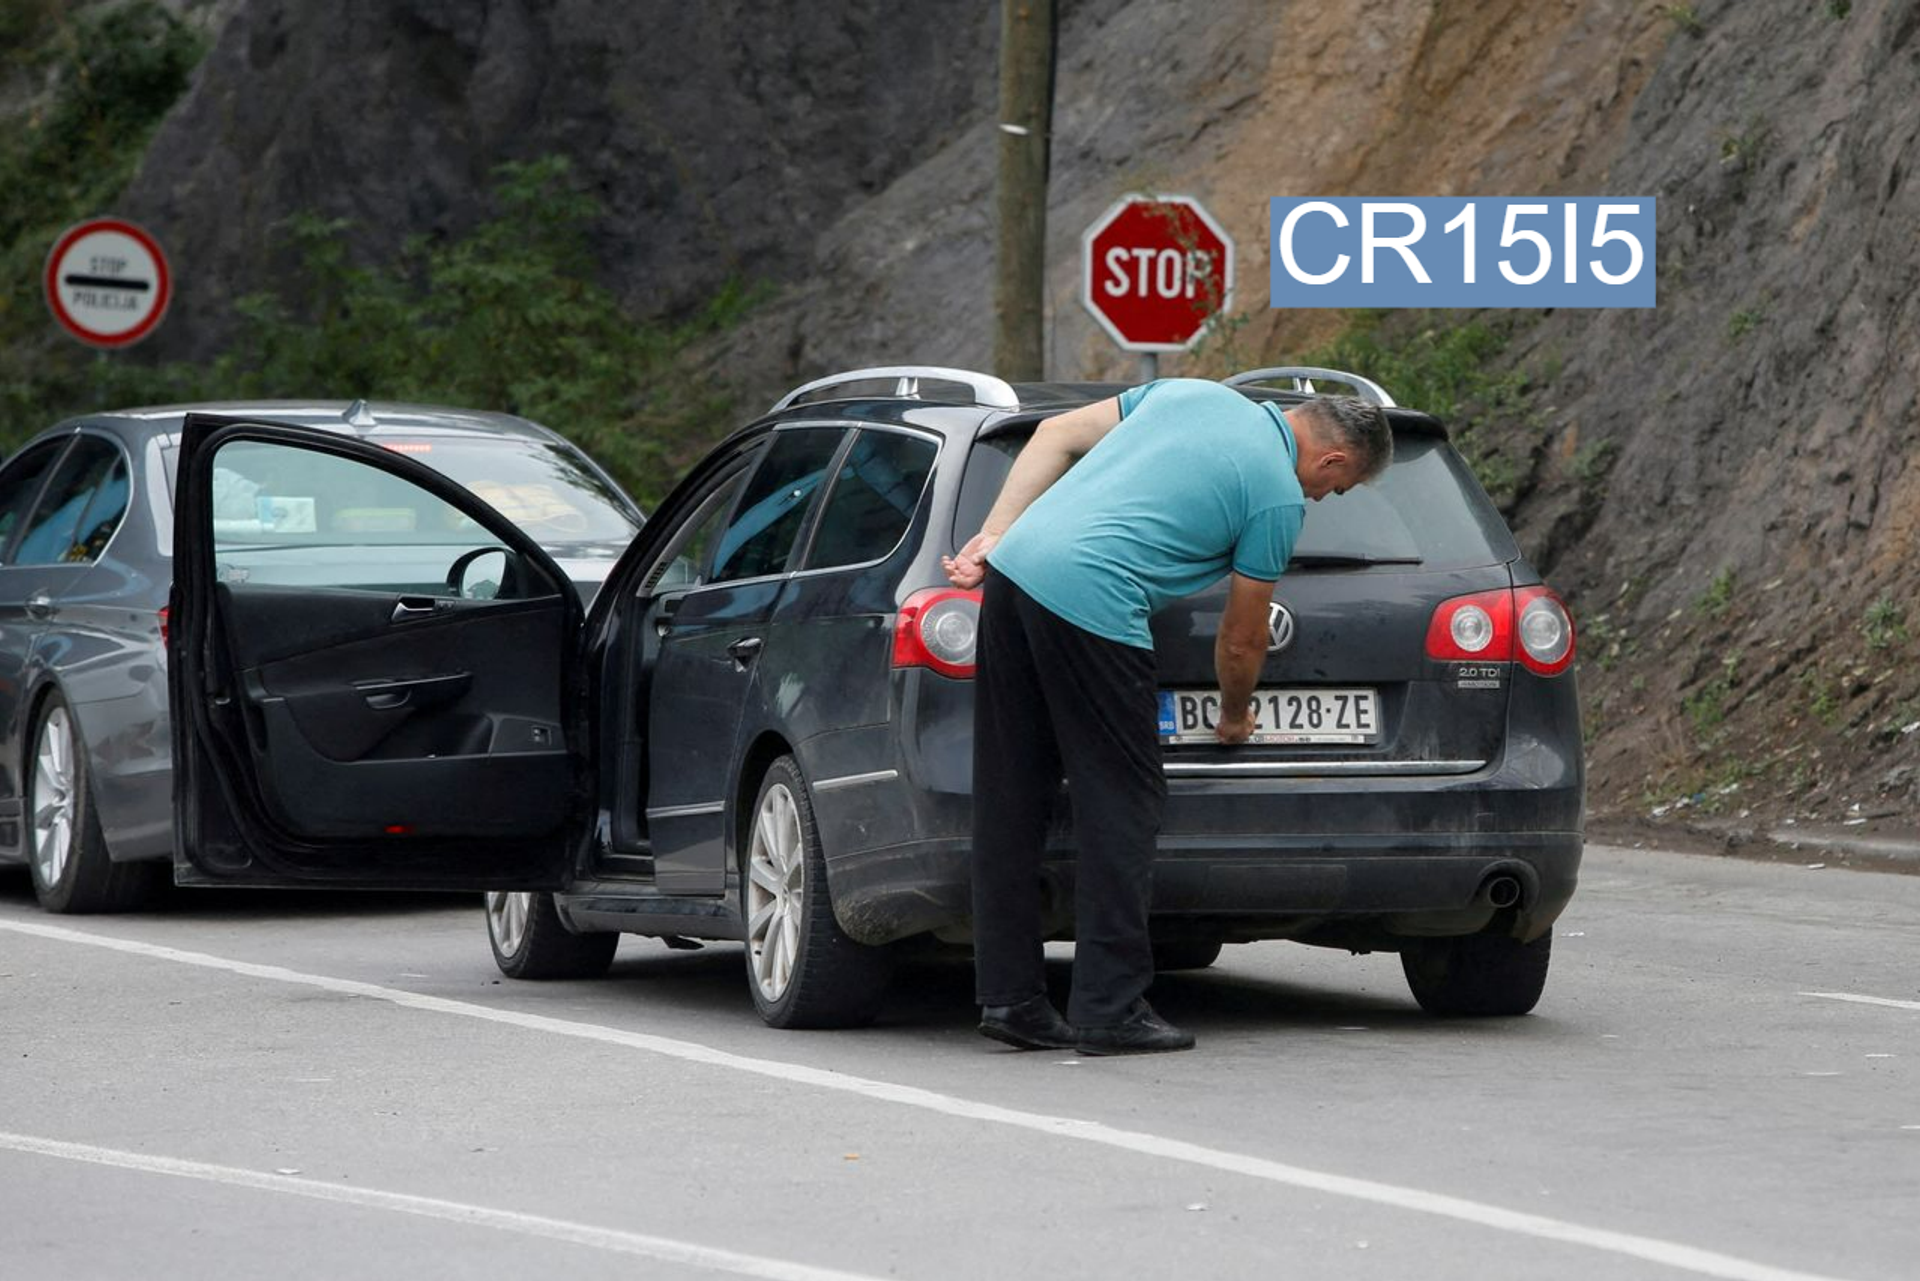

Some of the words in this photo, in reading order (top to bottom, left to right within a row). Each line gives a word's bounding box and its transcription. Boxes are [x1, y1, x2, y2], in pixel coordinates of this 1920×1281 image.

[90, 256, 128, 275] STOP
[1104, 247, 1213, 298] STOP
[1479, 668, 1500, 677] TDI
